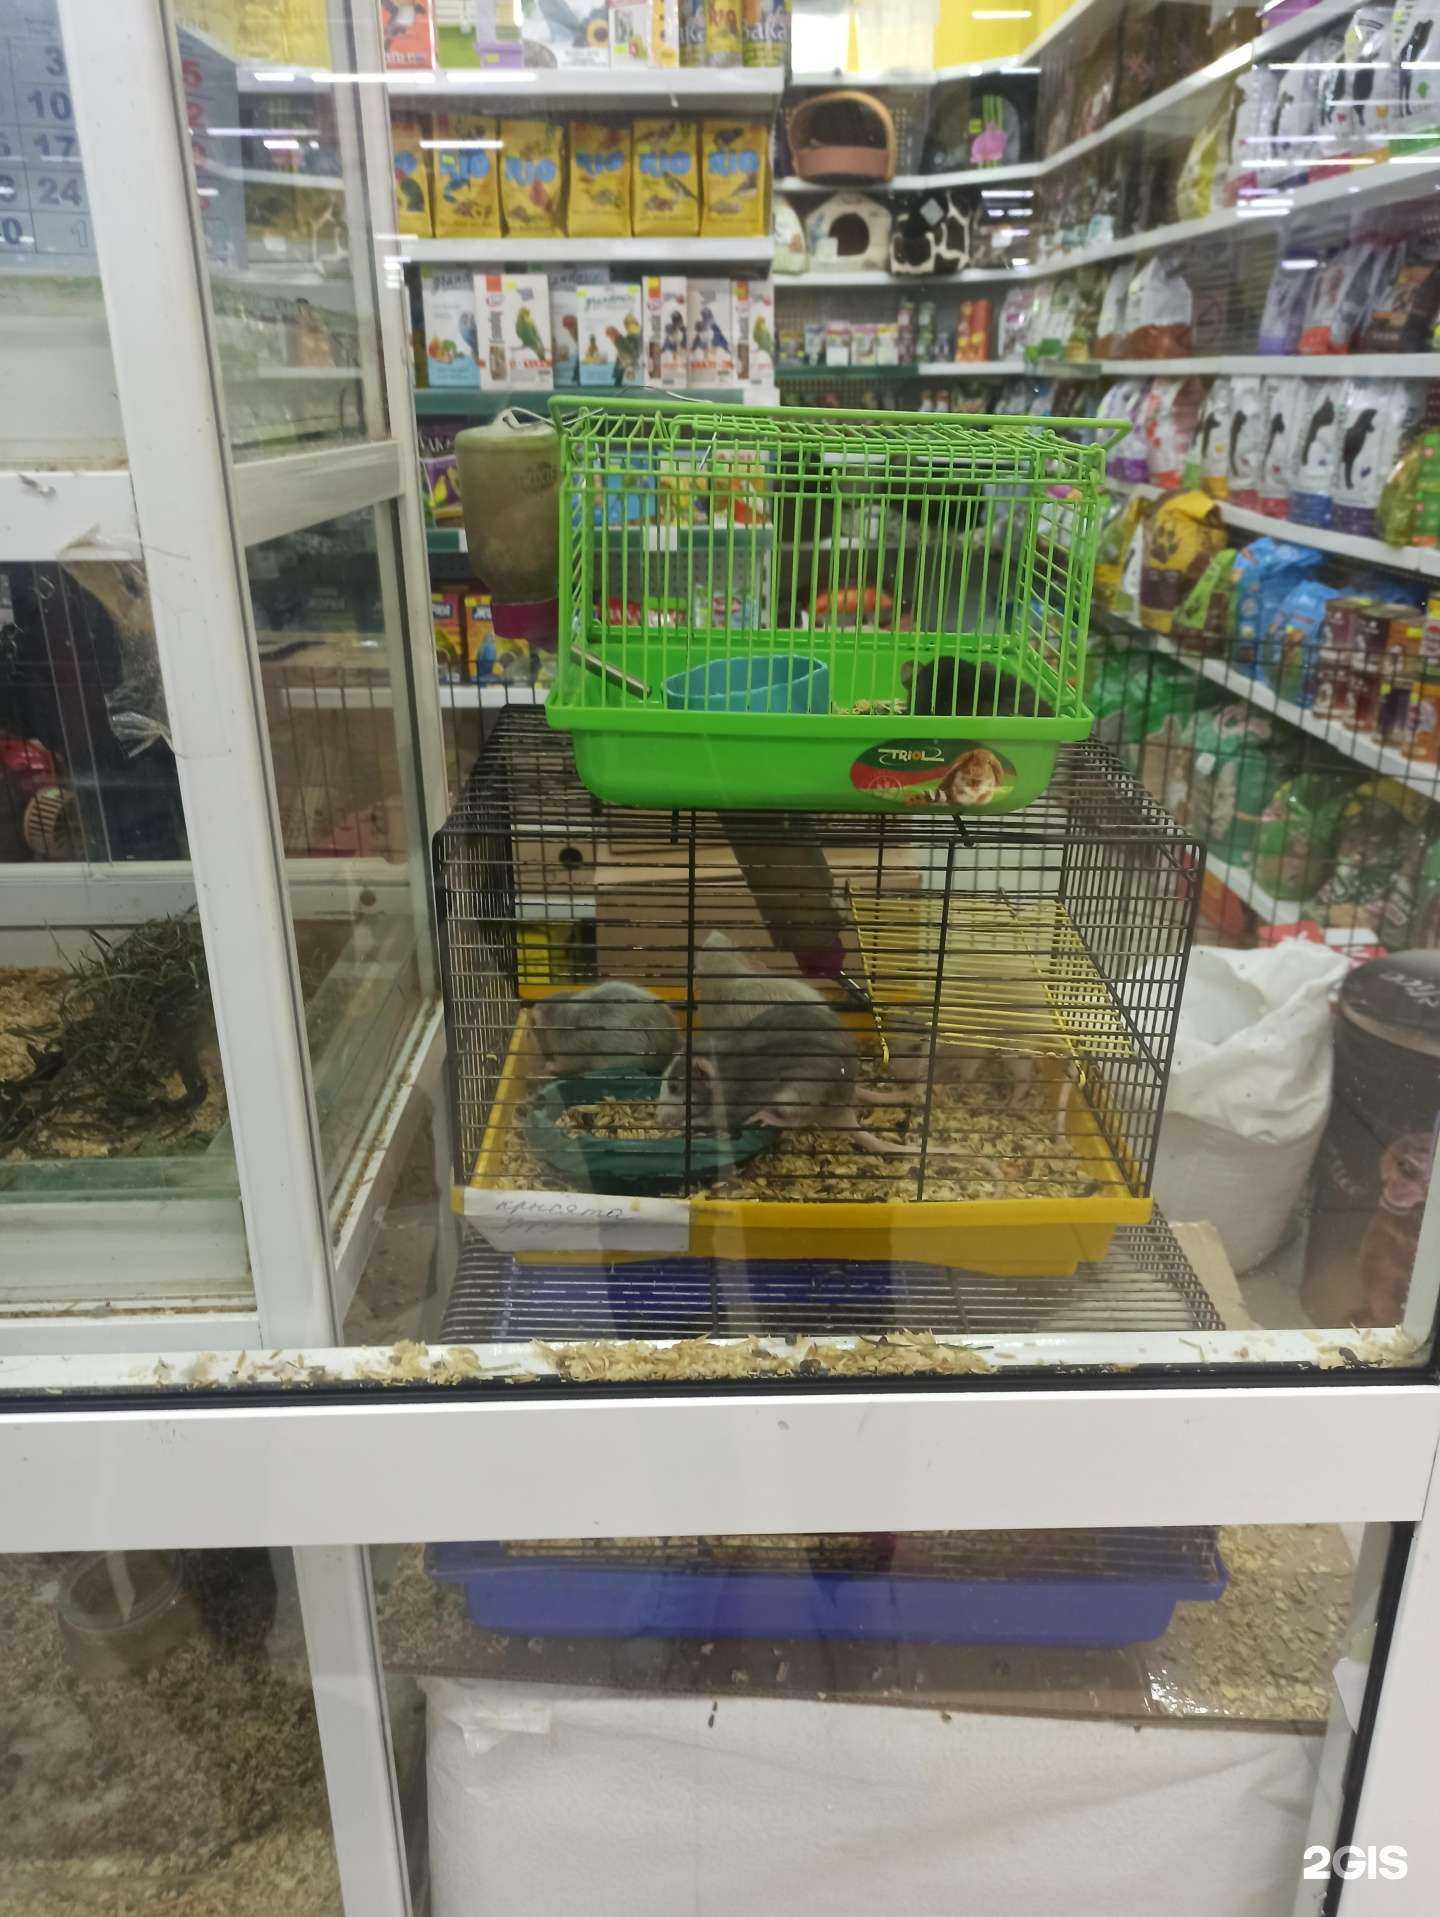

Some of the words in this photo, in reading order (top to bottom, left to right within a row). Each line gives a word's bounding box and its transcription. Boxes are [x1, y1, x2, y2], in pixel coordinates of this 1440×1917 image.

[45, 47, 66, 77] 3
[28, 90, 73, 121] 10
[33, 133, 77, 158] 17
[39, 177, 81, 207] 24
[878, 747, 945, 765] TRIOL
